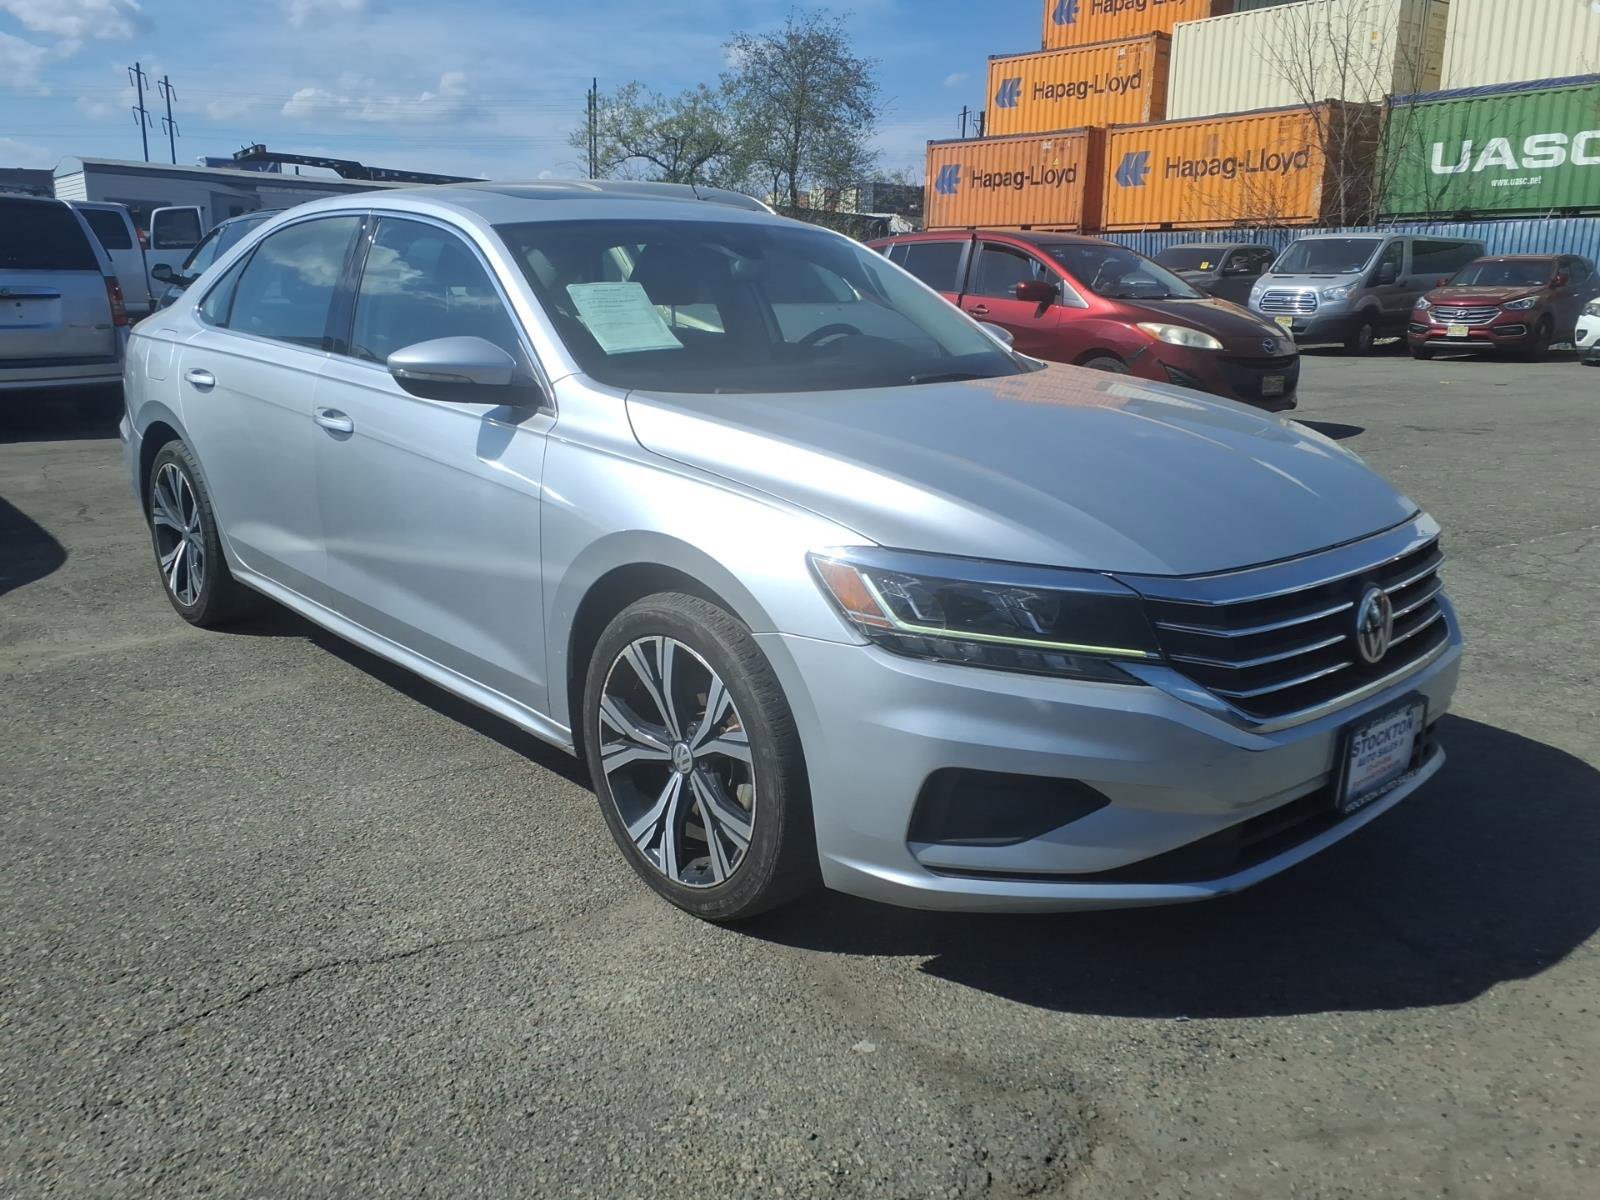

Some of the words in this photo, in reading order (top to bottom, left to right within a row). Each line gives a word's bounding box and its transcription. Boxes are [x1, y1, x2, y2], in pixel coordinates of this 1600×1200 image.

[1033, 70, 1141, 101] Hapag-Lloyd
[971, 163, 1077, 191] Hapag-Lloyd
[1165, 146, 1311, 182] Hapag-Lloyd
[1491, 176, 1542, 188] www.uasc.net
[1352, 717, 1414, 758] STOCKTON
